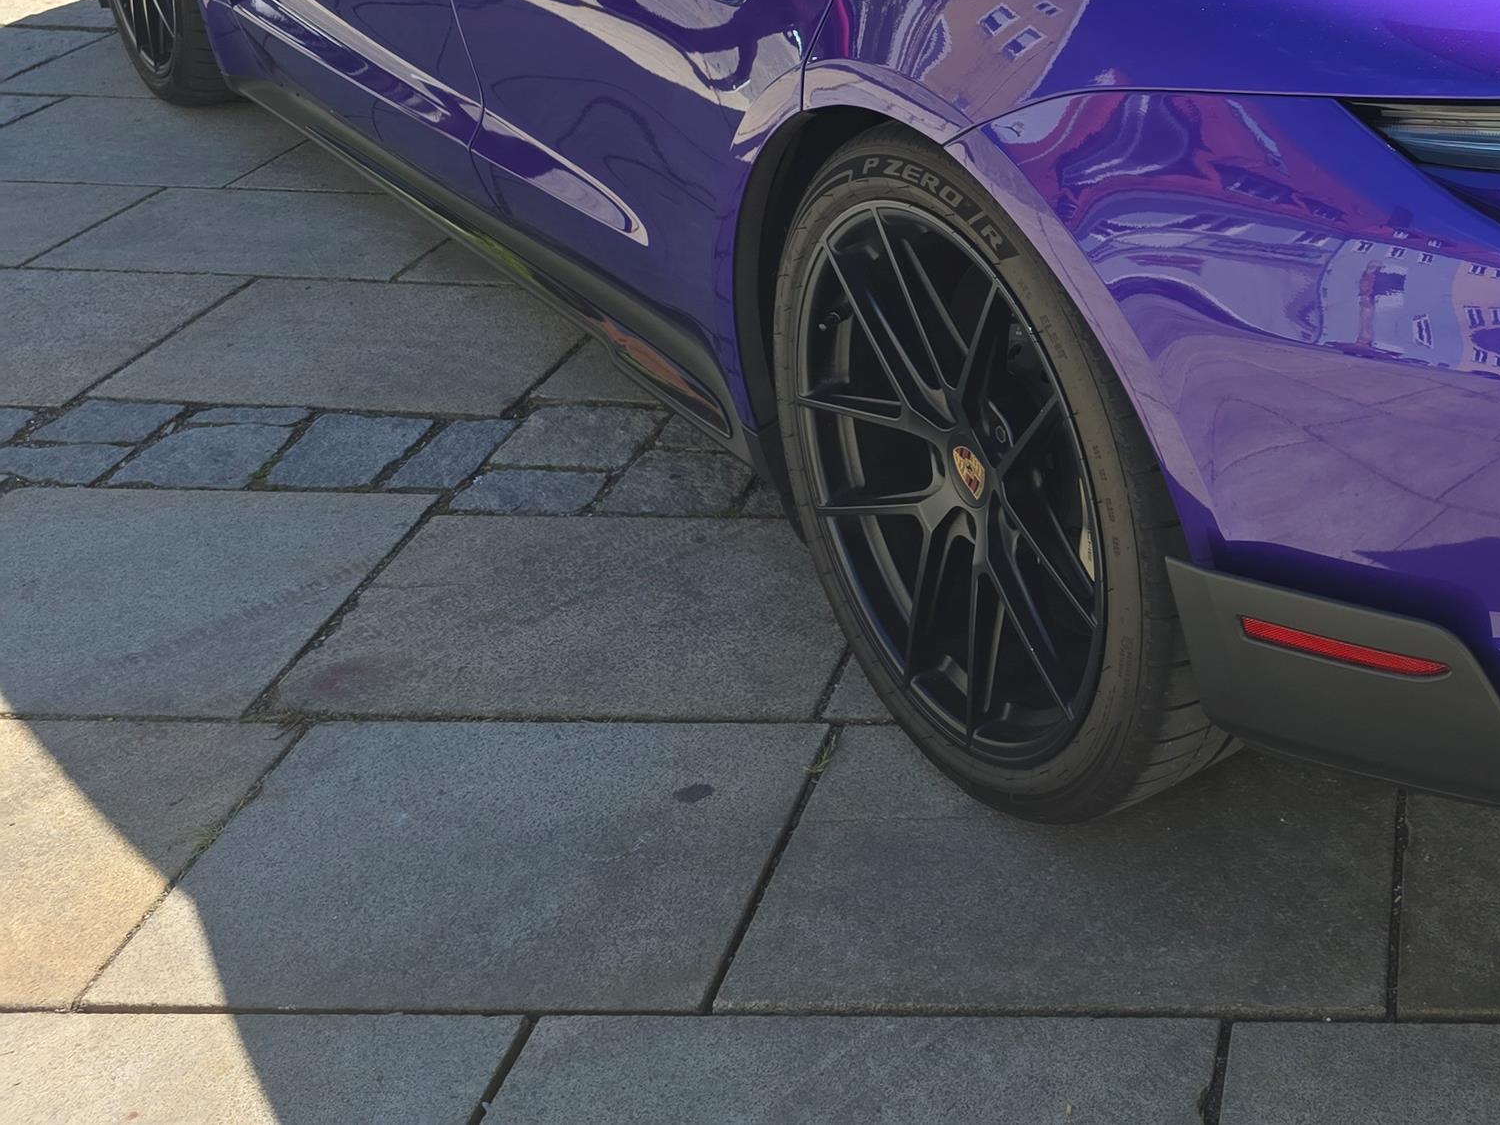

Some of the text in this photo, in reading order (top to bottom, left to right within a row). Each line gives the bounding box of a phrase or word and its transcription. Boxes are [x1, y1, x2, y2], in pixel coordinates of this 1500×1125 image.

[863, 156, 1005, 251] P ZERO R
